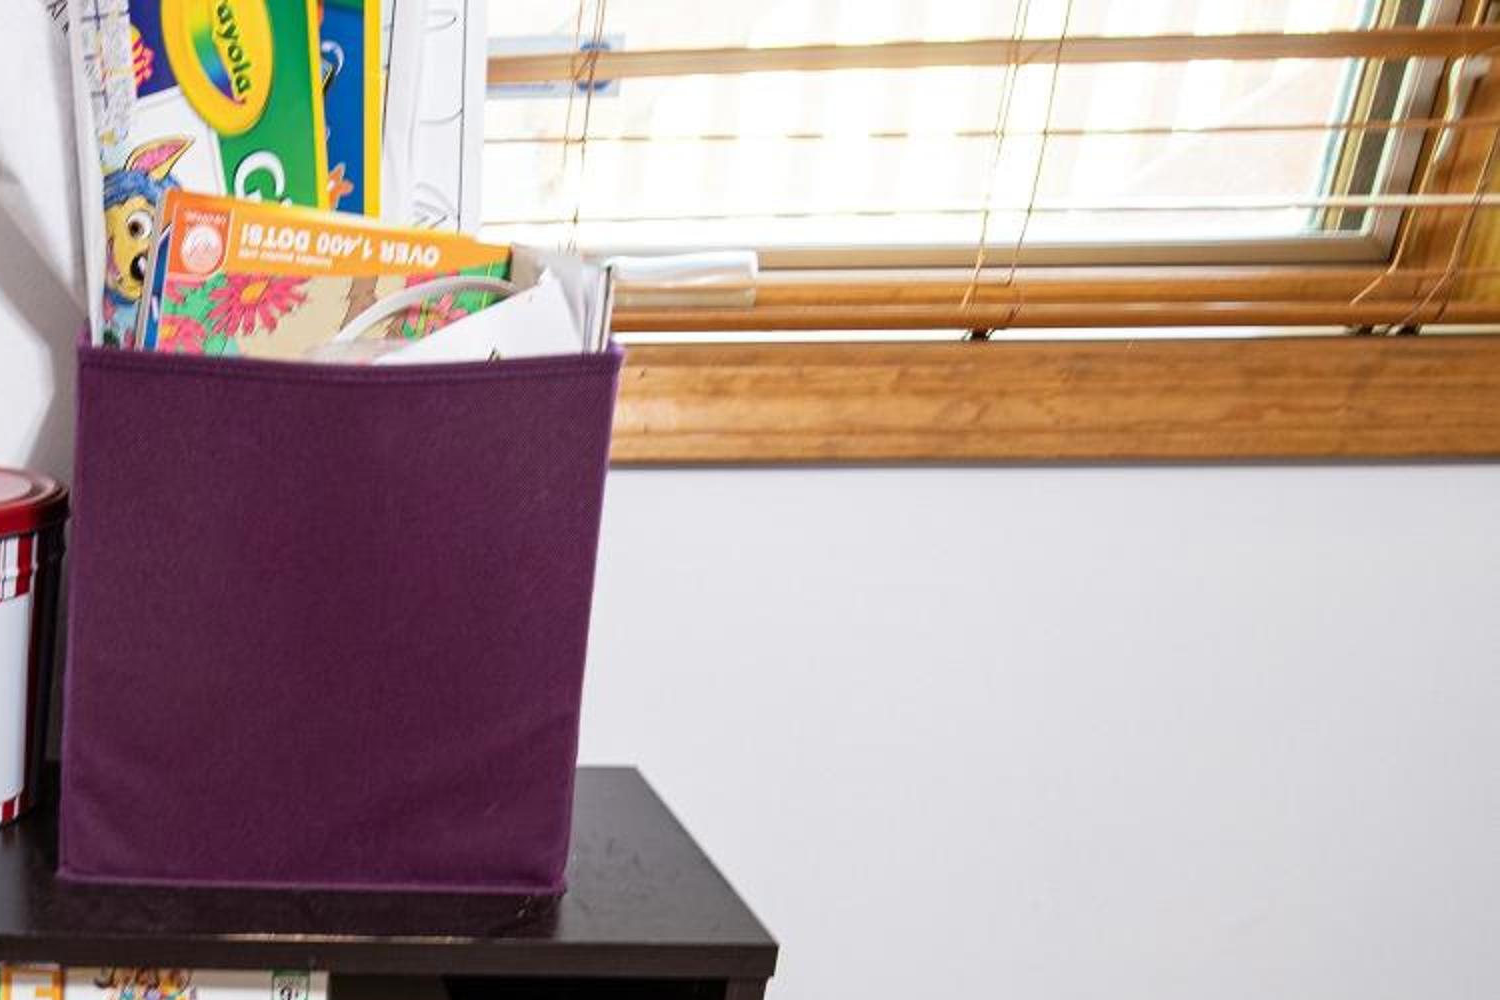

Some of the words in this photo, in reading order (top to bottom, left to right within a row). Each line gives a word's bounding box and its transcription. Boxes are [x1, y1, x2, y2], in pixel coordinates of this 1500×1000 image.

[213, 0, 251, 95] ayola
[240, 222, 311, 254] DOTS!
[380, 240, 441, 268] OVER
